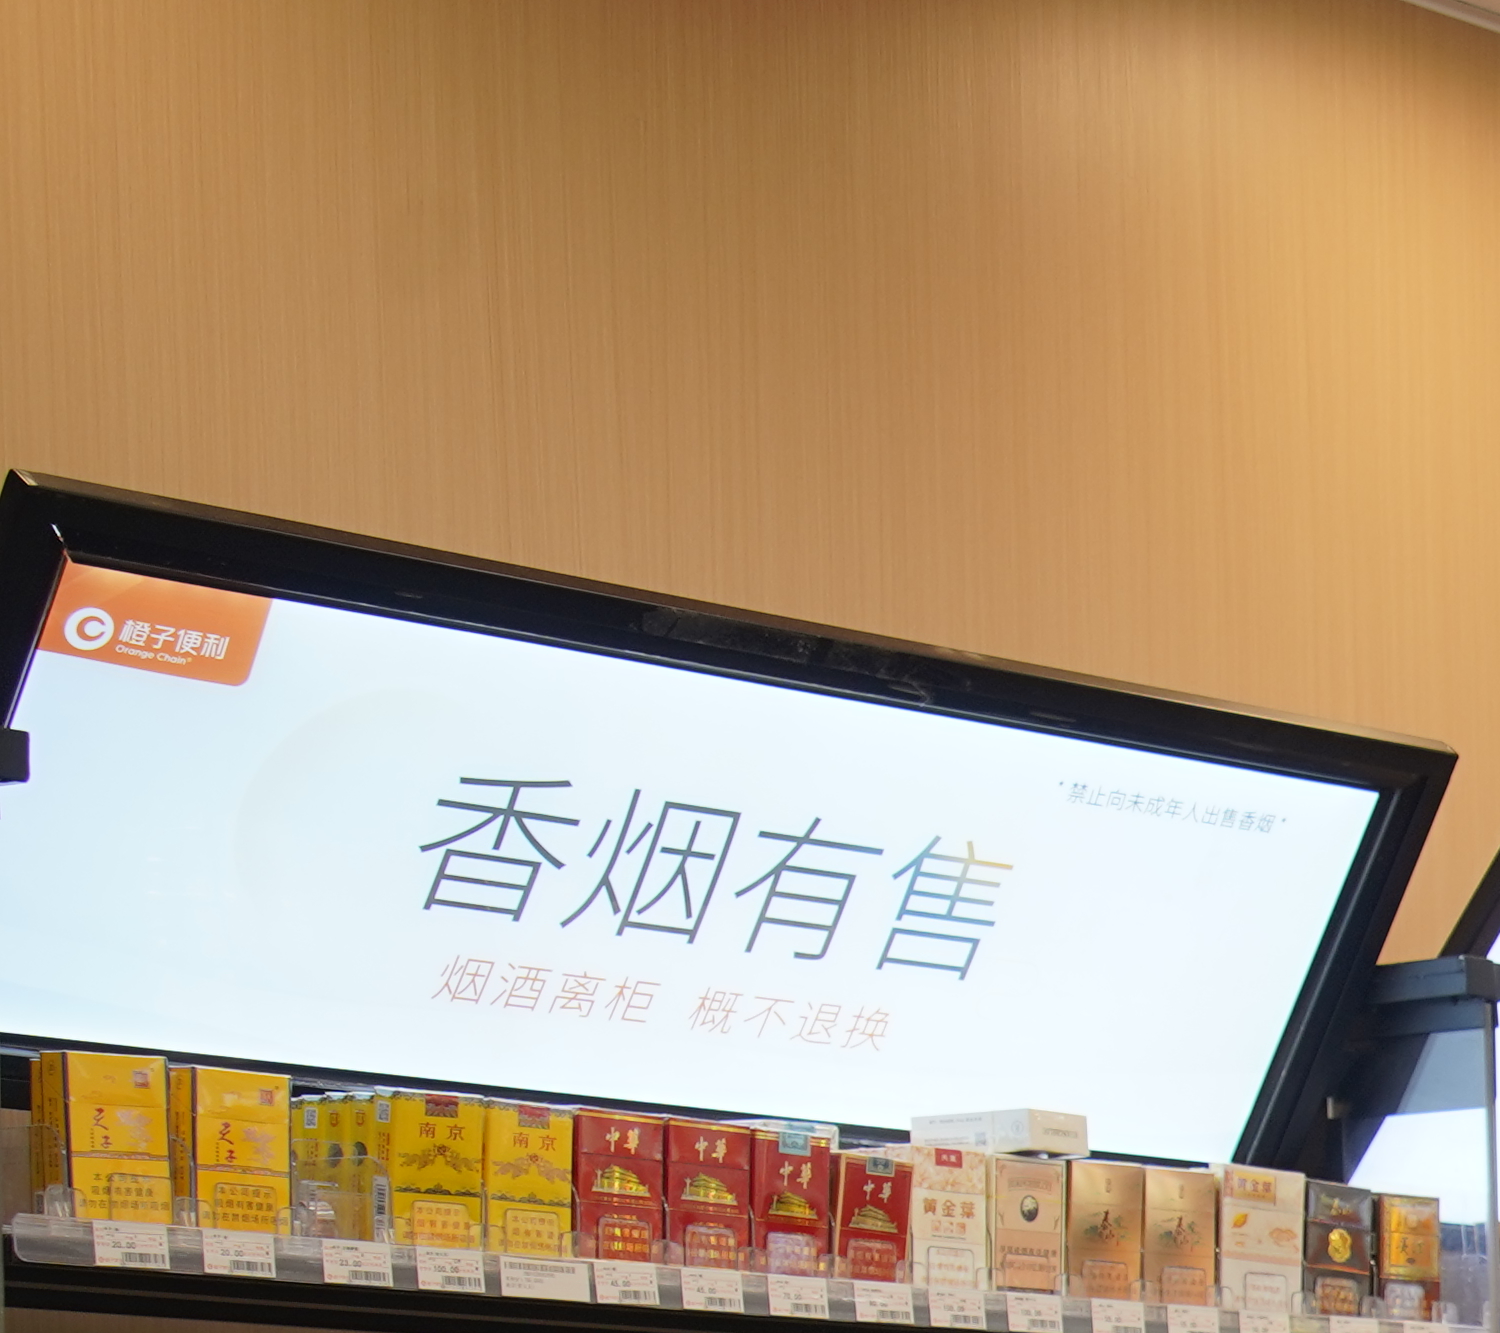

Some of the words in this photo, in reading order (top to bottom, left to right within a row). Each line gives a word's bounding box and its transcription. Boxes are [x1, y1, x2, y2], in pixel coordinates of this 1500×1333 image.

[115, 644, 155, 660] Orange
[155, 652, 187, 666] Chain
[118, 618, 231, 661] 橙子便利
[418, 776, 1014, 981] 香烟有售
[431, 953, 662, 1025] 烟酒离柜
[686, 986, 892, 1052] 概不退换
[419, 1121, 466, 1141] 南京
[512, 1131, 557, 1152] 南京
